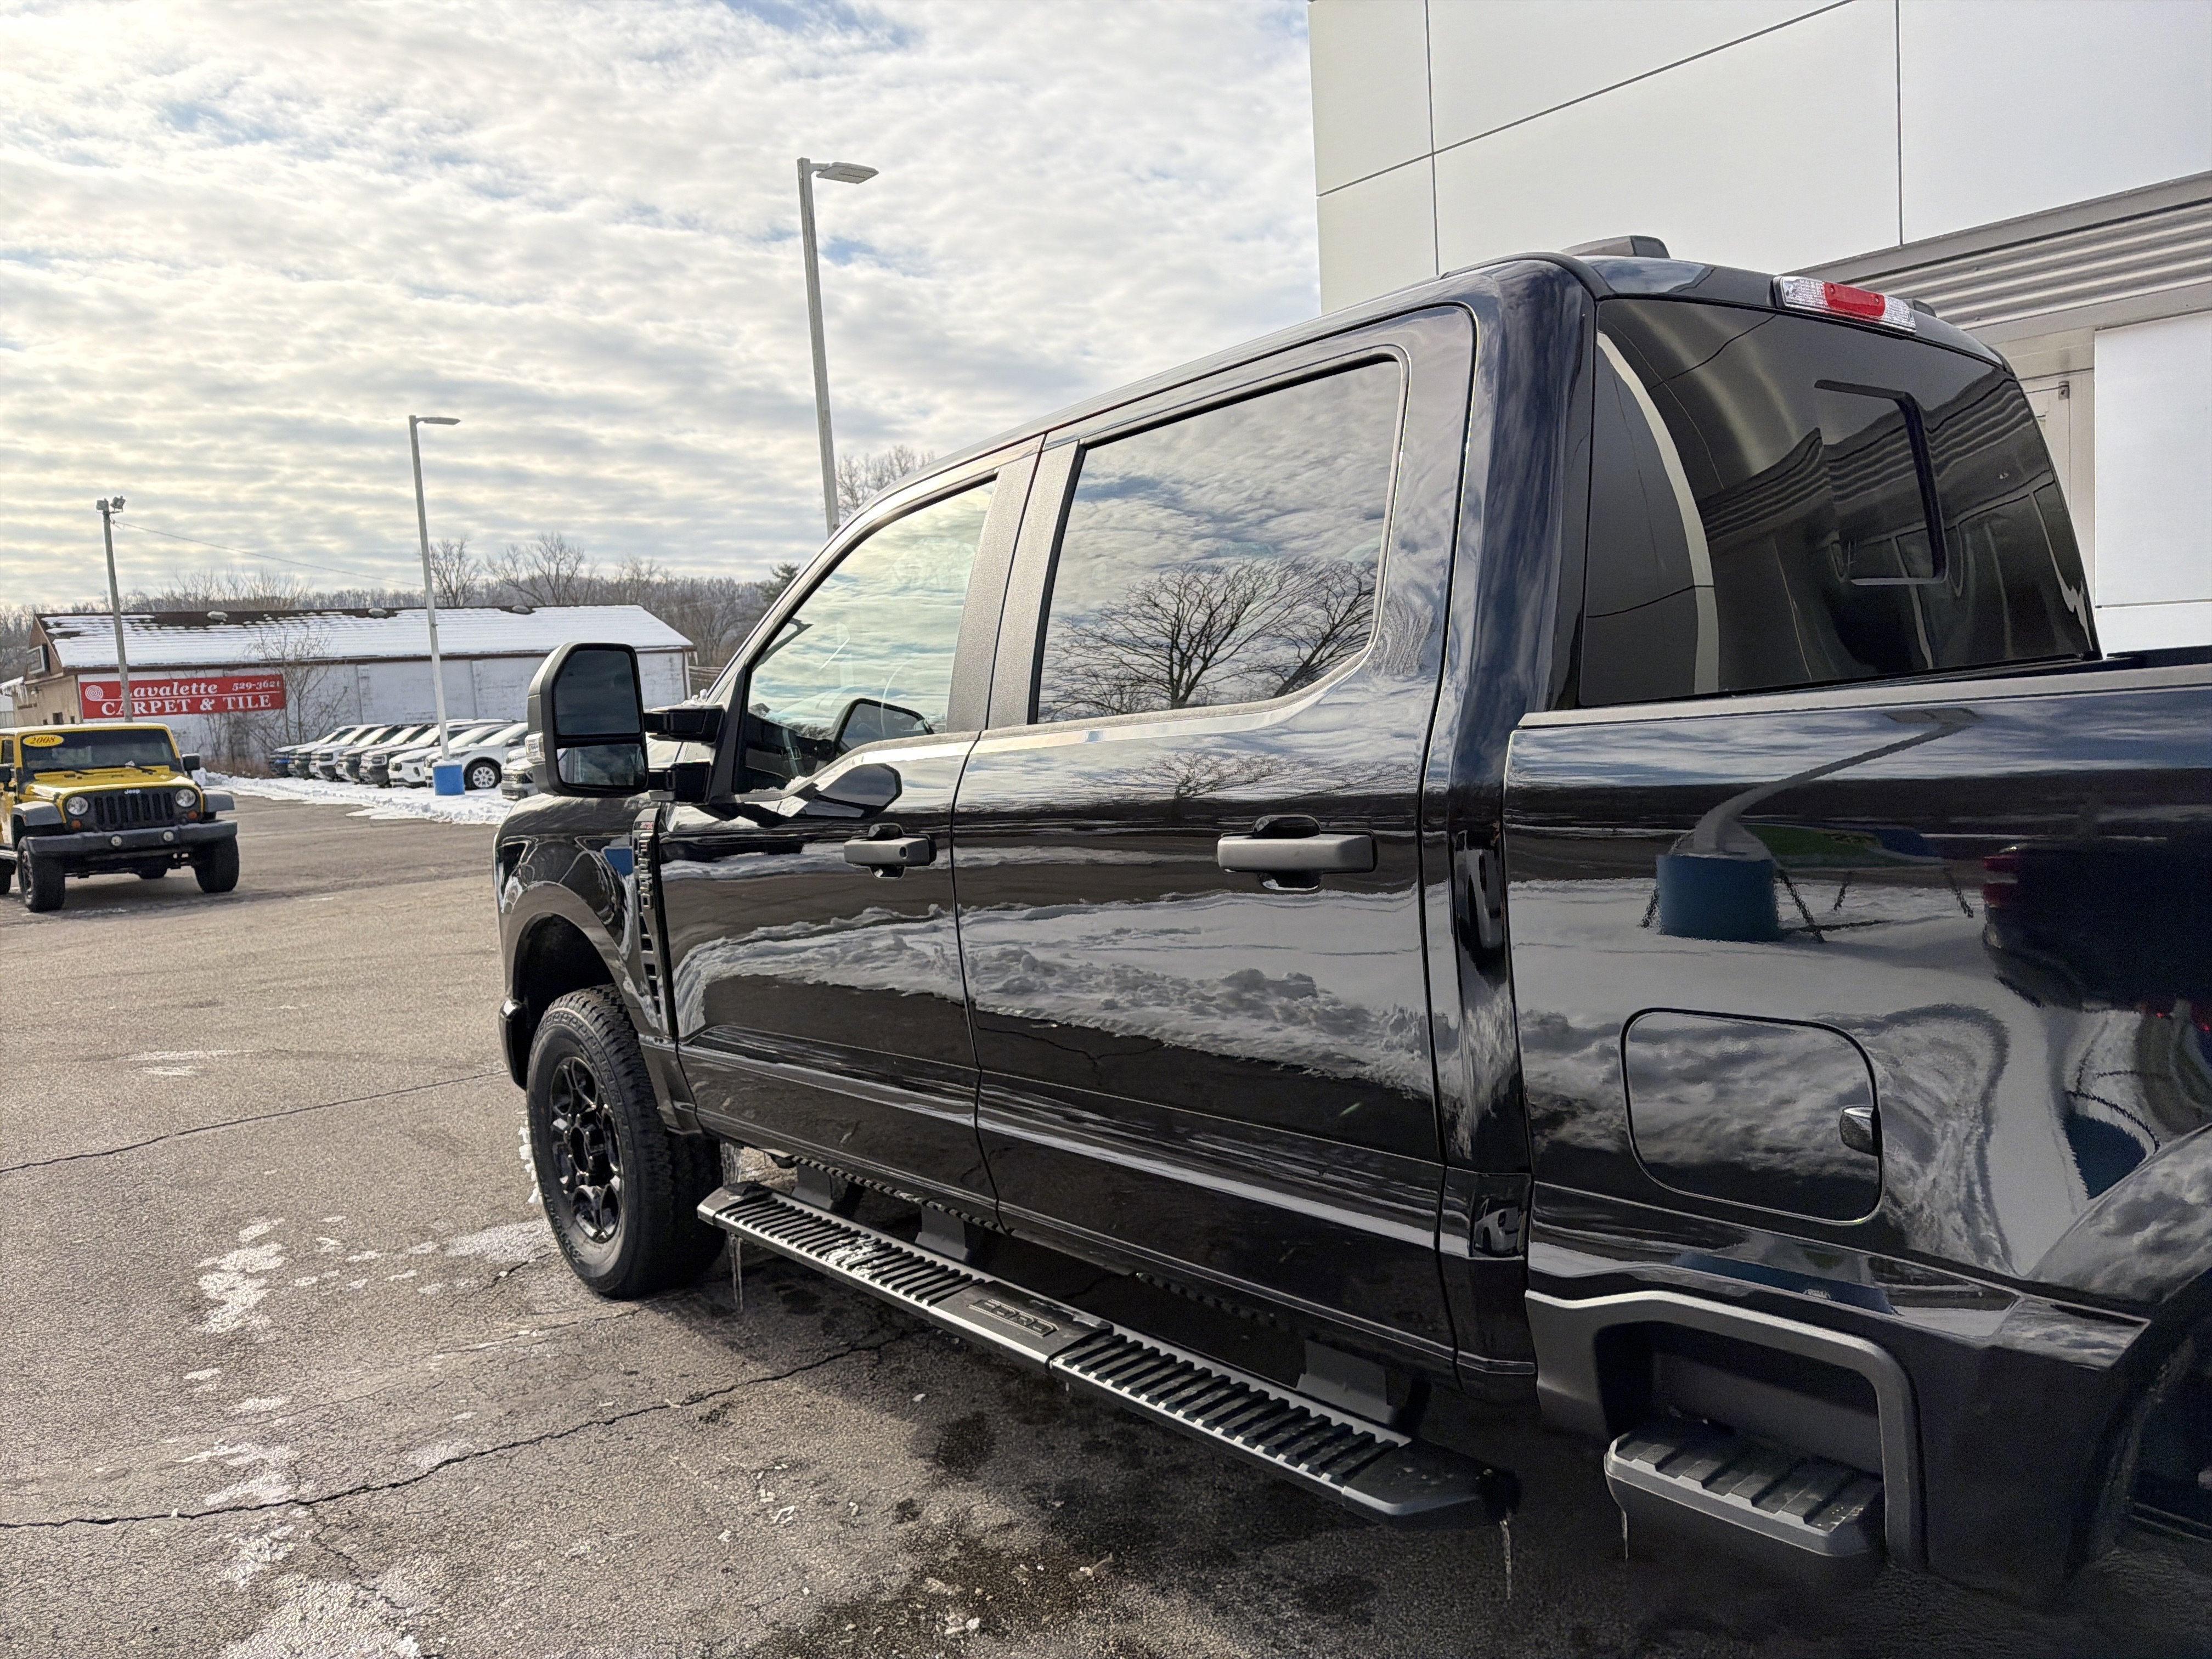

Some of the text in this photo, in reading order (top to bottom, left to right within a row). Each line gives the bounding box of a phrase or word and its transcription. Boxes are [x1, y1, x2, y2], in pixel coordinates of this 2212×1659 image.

[119, 682, 218, 698] avalette
[200, 698, 215, 711] &
[222, 695, 271, 709] TILE
[30, 736, 55, 744] 2008
